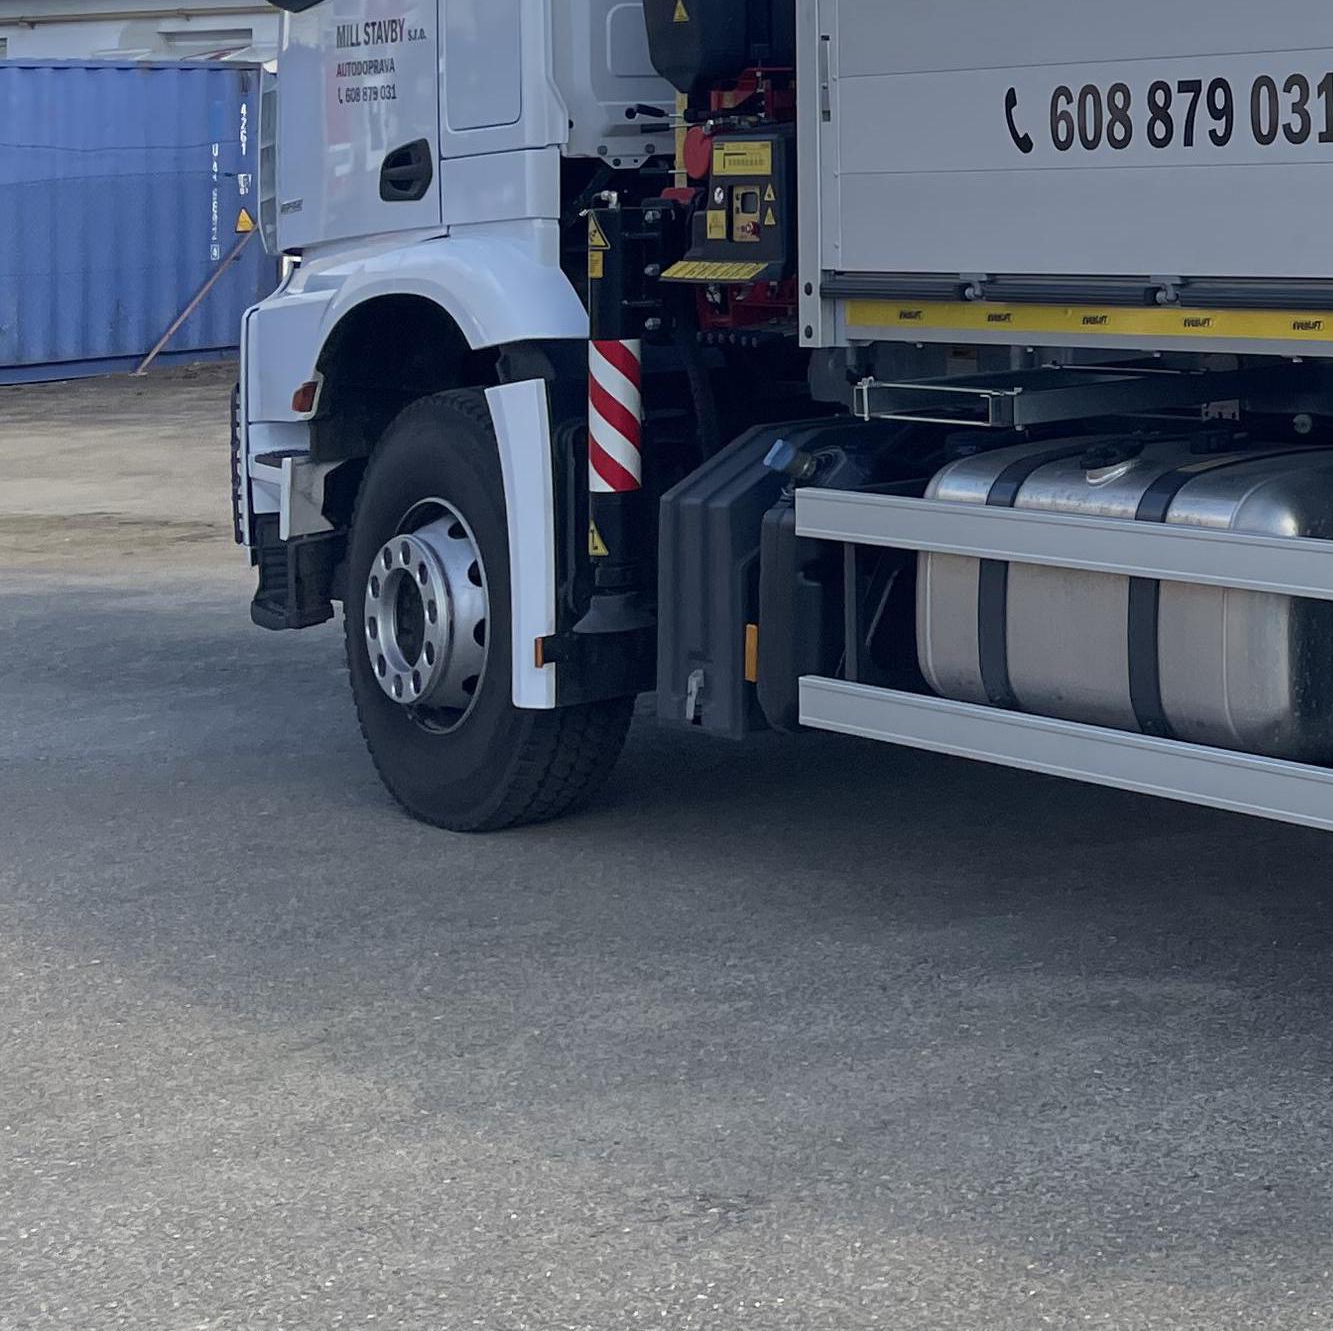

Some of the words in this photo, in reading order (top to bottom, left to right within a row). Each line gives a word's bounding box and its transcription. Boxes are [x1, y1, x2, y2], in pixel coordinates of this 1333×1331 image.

[336, 23, 362, 49] MILL
[363, 18, 406, 46] STAVBY
[336, 57, 396, 79] AUTODOPRAVA
[380, 83, 397, 100] 031
[1050, 82, 1133, 151] 608
[1147, 77, 1234, 148] 879
